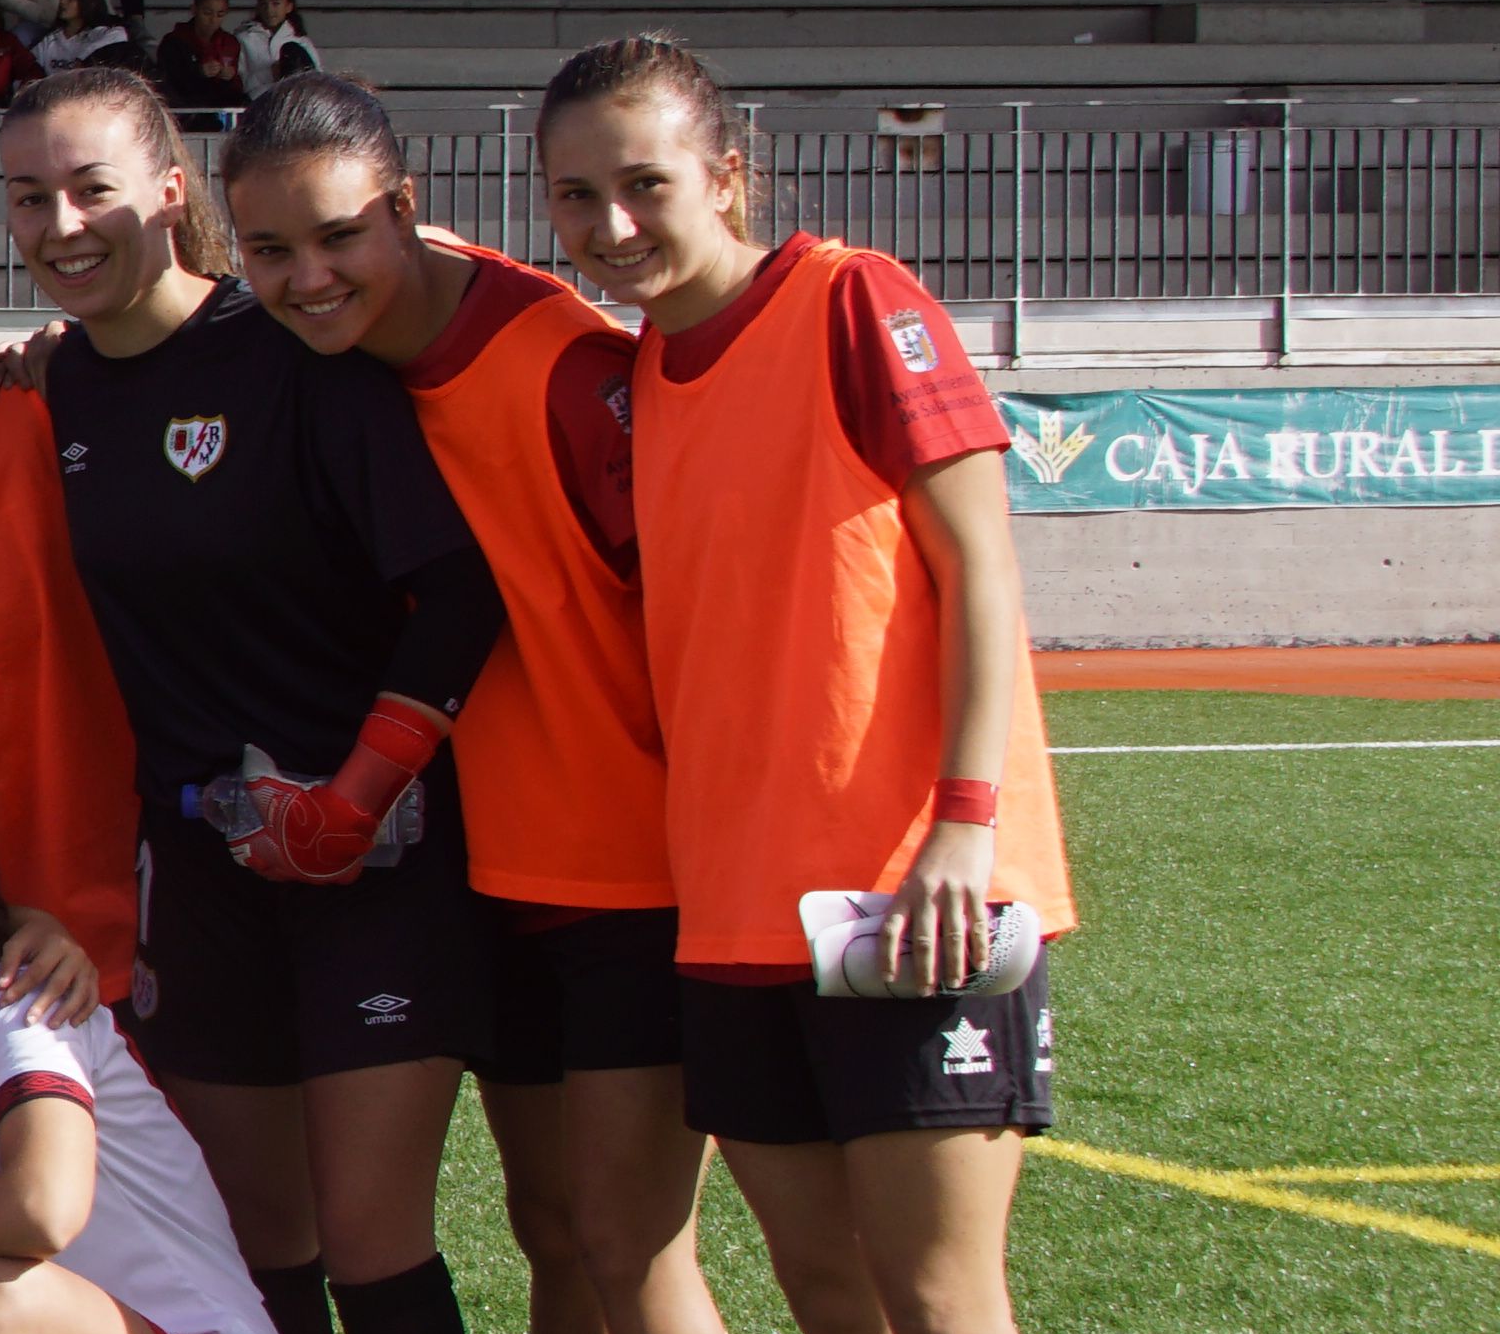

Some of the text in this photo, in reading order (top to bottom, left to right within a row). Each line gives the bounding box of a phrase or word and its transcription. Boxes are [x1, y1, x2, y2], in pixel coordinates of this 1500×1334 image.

[1104, 430, 1256, 494] CAJA
[1264, 427, 1466, 479] RURAL
[364, 1011, 407, 1025] umbro
[943, 1057, 994, 1075] luanvi
